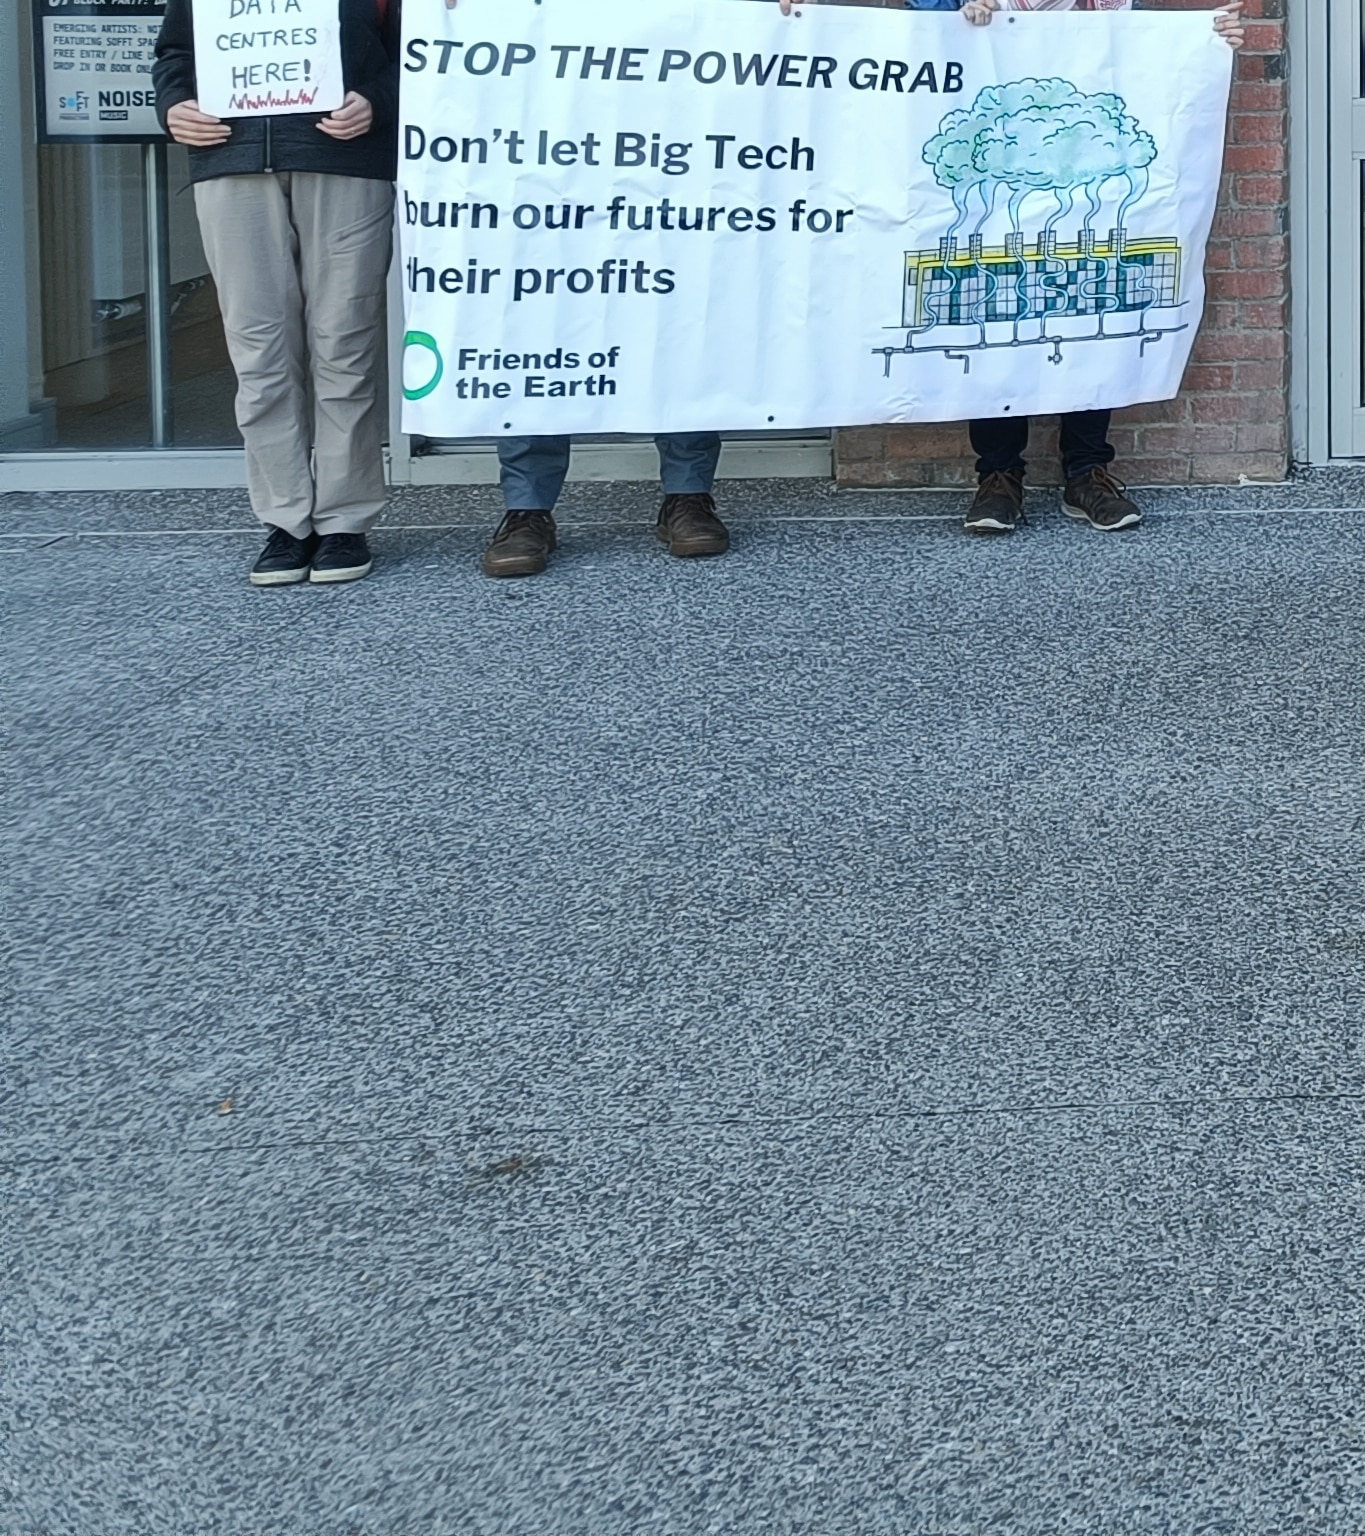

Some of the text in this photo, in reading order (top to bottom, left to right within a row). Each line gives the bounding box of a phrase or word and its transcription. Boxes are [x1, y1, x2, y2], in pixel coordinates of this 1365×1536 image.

[53, 49, 75, 58] FREE
[216, 28, 317, 51] CENTRES
[232, 59, 311, 89] HERE!
[404, 38, 964, 93] STOP THE POWER GRAB
[98, 91, 156, 107] NOISE
[537, 130, 601, 166] let
[614, 131, 692, 175] Big
[705, 135, 815, 171] Tech
[404, 189, 854, 234] burn our futures for
[513, 259, 676, 302] profits
[457, 346, 620, 372] Friends of
[456, 375, 617, 400] the Earth
